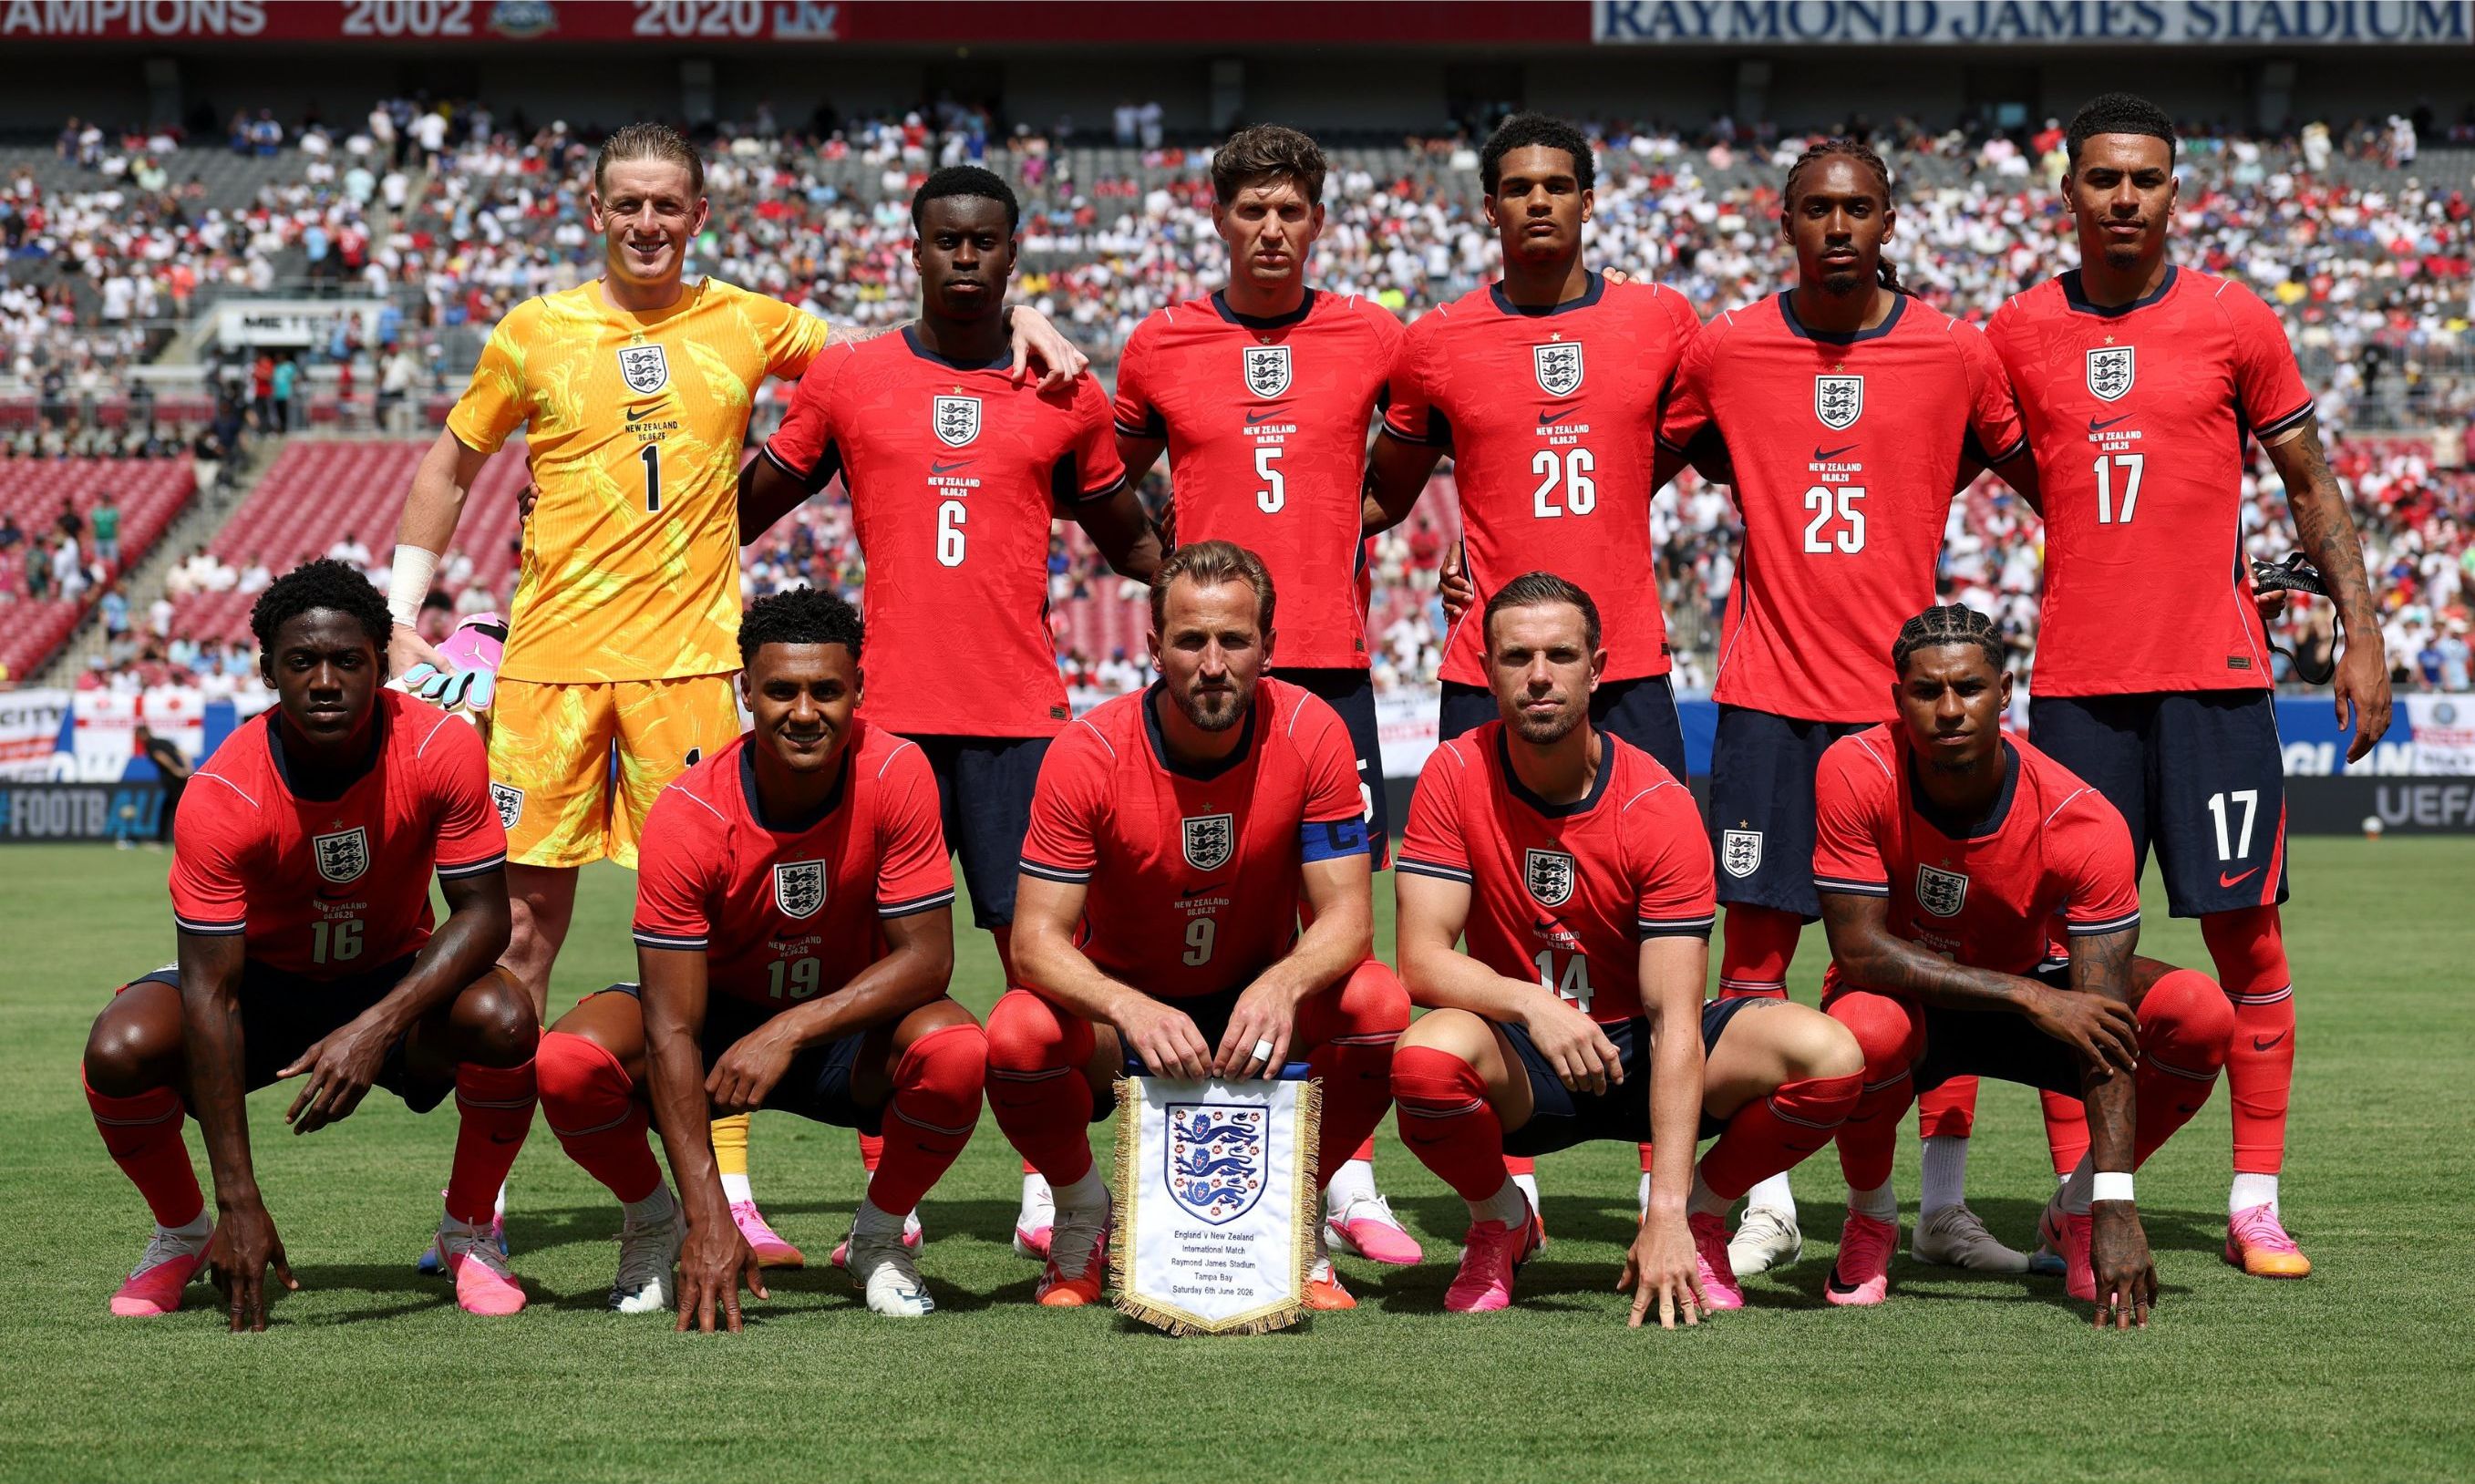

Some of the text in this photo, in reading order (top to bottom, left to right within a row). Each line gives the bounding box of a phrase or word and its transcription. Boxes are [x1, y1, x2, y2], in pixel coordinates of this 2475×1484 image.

[341, 0, 474, 36] 2002
[631, 0, 765, 37] 2020
[1603, 0, 1940, 38] RAYMOND
[1950, 0, 2166, 39] JAMES
[625, 420, 678, 433] NEW ZEALAND
[1243, 425, 1296, 435] NEW ZEALAND
[1535, 425, 1590, 436] NEW ZEALAND
[638, 432, 665, 441] 06.06.26
[2088, 430, 2142, 442] NEW ZEALAND
[1809, 463, 1861, 472] NEW ZEALAND
[641, 444, 661, 512] 1
[928, 476, 981, 488] NEW ZEALAND
[1254, 447, 1285, 514] 5
[1531, 447, 1596, 519] 26
[2093, 452, 2144, 524] 17
[1803, 485, 1867, 555] 25
[935, 500, 967, 569] 6
[2208, 789, 2258, 861] 17
[313, 899, 328, 912] NEW
[1174, 897, 1229, 909] NEW ZEALAND
[312, 919, 364, 964] 16
[768, 941, 786, 952] NEW
[1182, 917, 1216, 966] 9
[768, 957, 820, 999] 19
[1535, 950, 1594, 1014] 14
[1174, 1231, 1201, 1240] England
[1211, 1232, 1225, 1240] New
[1227, 1232, 1254, 1242] Zealand
[1181, 1245, 1245, 1254] International Match
[1170, 1258, 1256, 1269] Raymond James Stadium
[1194, 1272, 1232, 1283] Tampa Bay
[1172, 1285, 1201, 1295] Saturday
[1236, 1287, 1254, 1296] 2026
